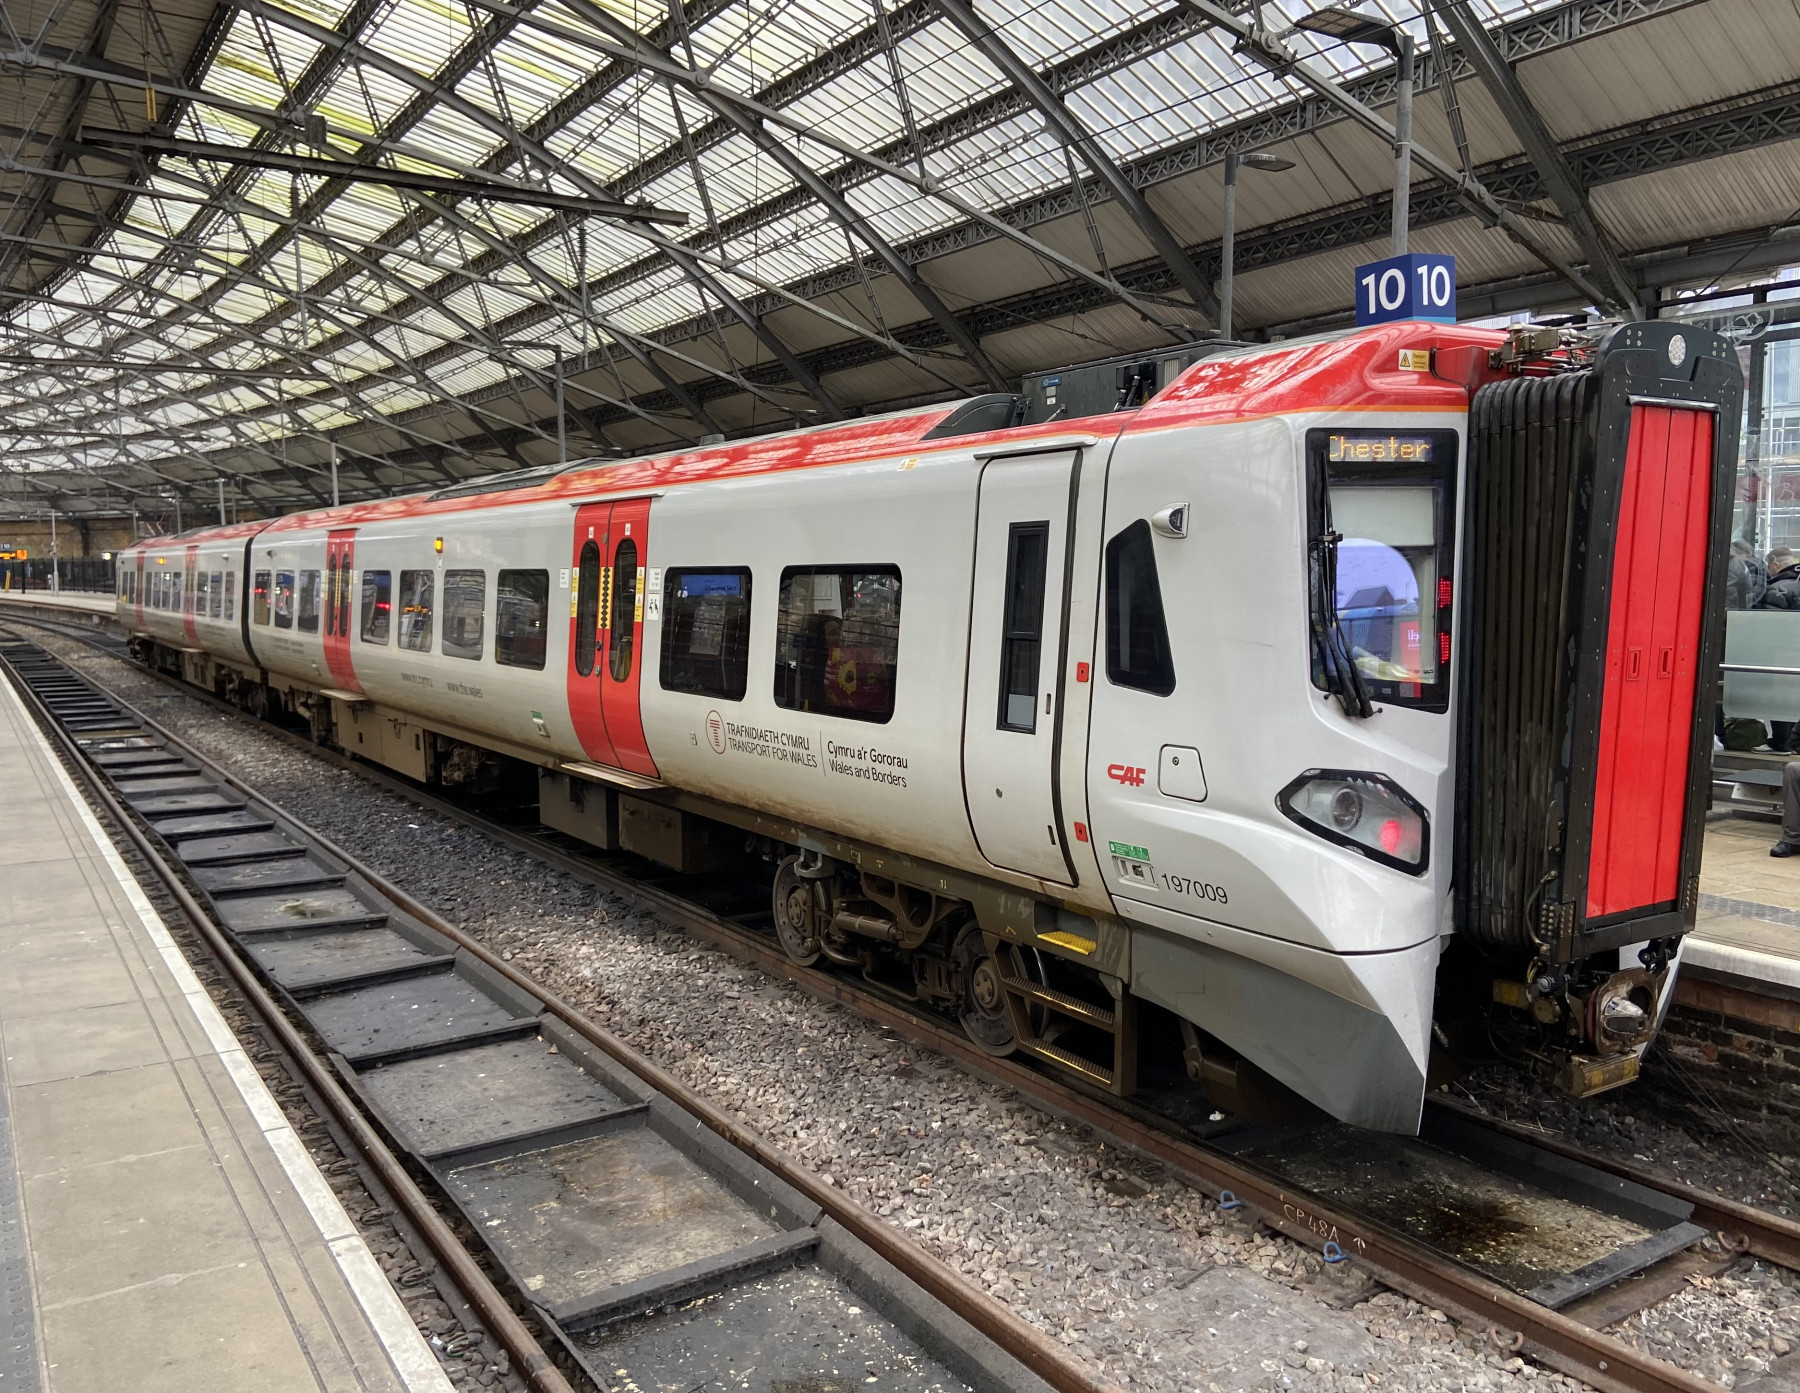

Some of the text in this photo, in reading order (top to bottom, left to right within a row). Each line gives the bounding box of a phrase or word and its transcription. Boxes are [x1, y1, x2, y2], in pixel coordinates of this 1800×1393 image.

[1362, 268, 1405, 314] 10
[1417, 264, 1450, 306] 10
[1329, 435, 1431, 458] Chester
[726, 722, 810, 751] TRAFNIDIAETH CYMRU
[728, 738, 818, 768] TRANSPORT FOR WALES
[827, 740, 909, 769] Cymru a'r Gororau
[829, 758, 907, 787] Wales and Borders
[1107, 763, 1146, 787] CAF
[1161, 873, 1228, 904] 197009
